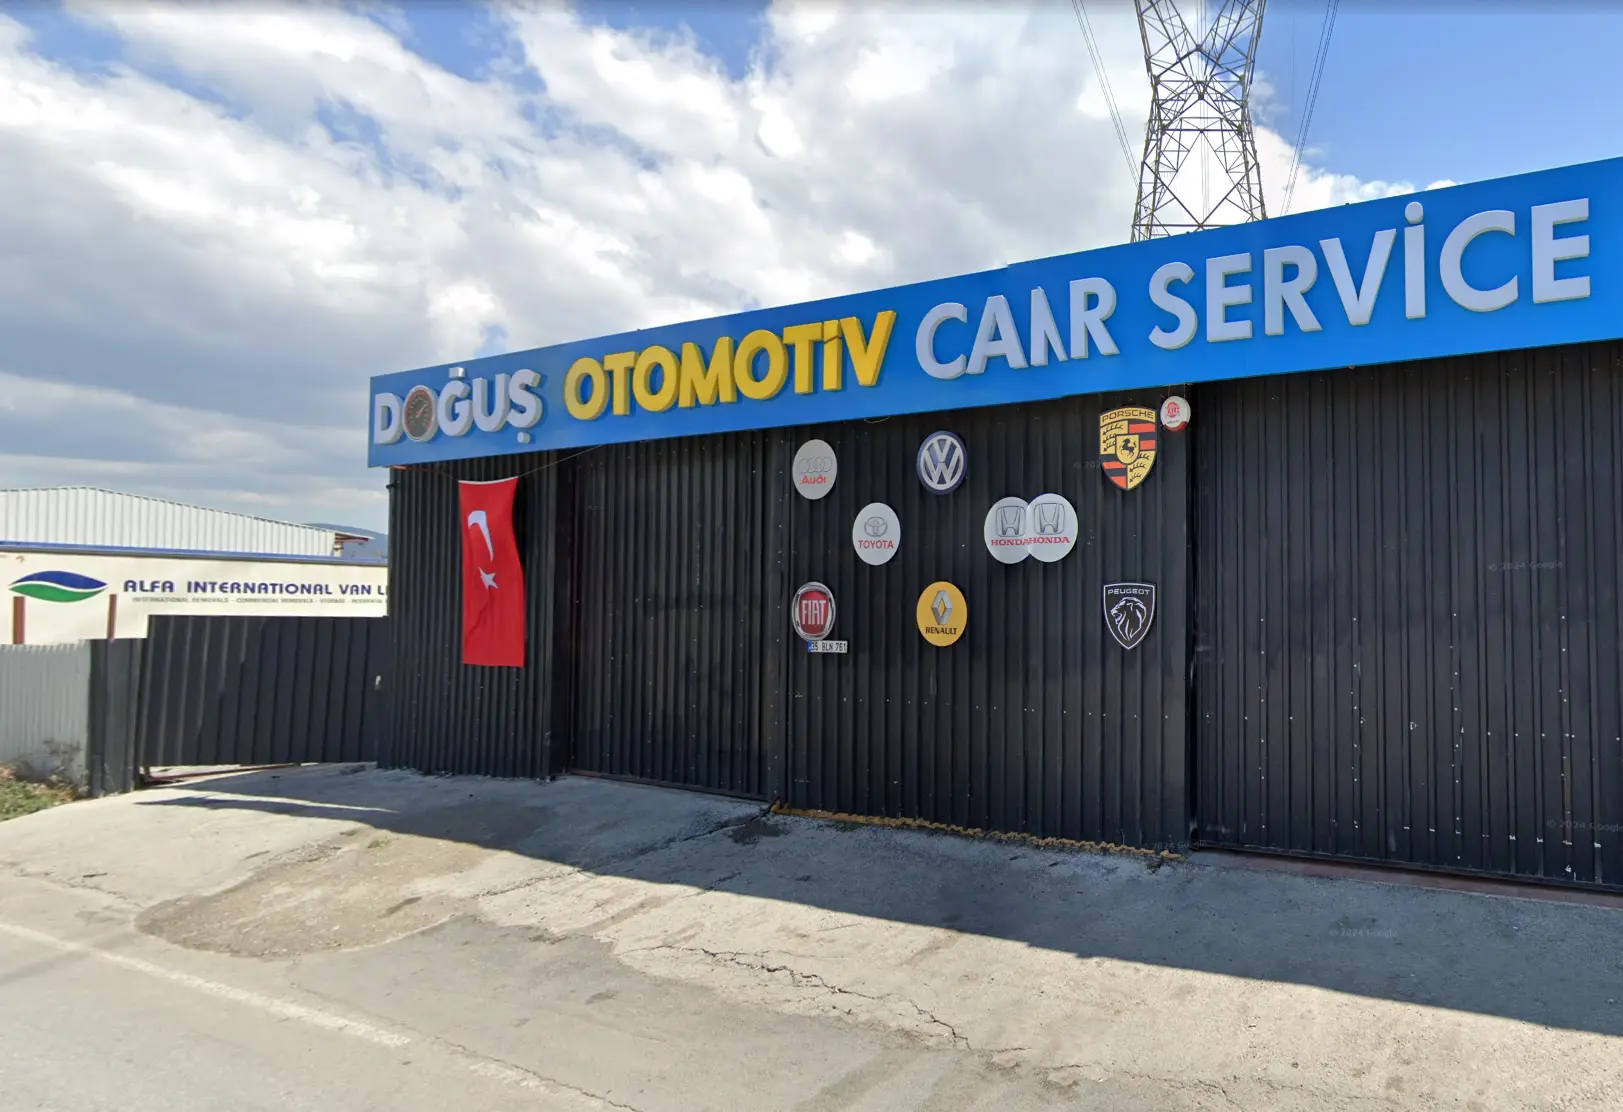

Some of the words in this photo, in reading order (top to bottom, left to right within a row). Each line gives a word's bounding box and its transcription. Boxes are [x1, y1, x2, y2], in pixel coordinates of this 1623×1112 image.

[1102, 409, 1154, 422] PORSCHE
[800, 474, 827, 484] Audi
[858, 540, 894, 549] TOYOTA
[991, 538, 1030, 547] HONDA
[1029, 536, 1070, 544] HONDA
[123, 579, 174, 592] ALFA
[187, 580, 333, 595] INTERNATIONAL
[339, 584, 372, 595] VAN
[1107, 588, 1151, 596] PEUGEOT
[801, 599, 827, 625] FIAT
[925, 626, 958, 635] RENAULT
